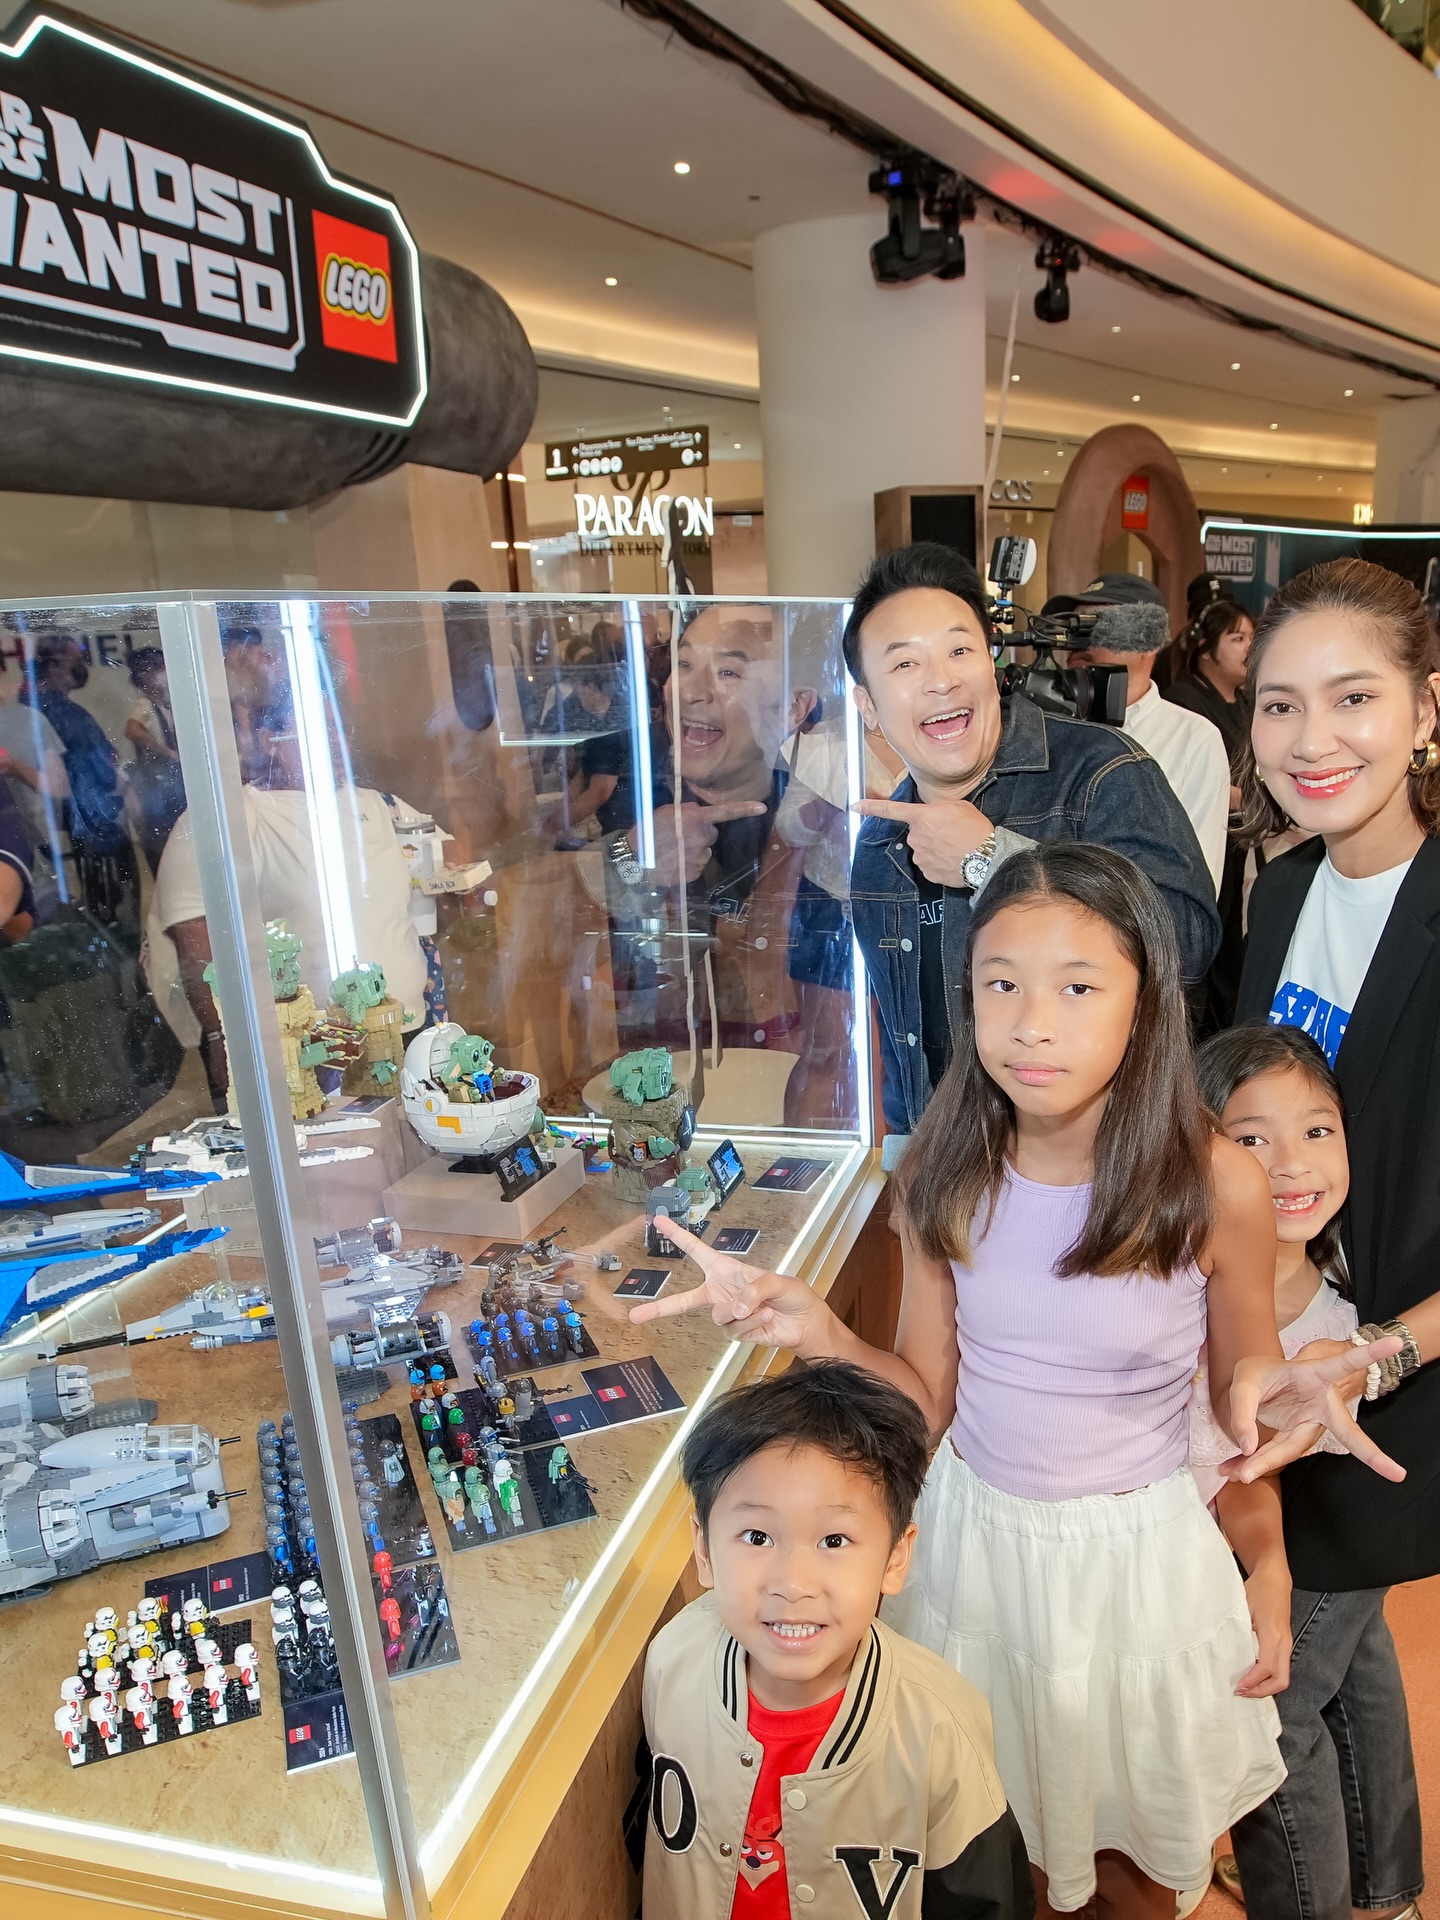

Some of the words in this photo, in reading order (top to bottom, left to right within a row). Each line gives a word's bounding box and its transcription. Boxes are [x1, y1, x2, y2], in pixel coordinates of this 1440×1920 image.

[41, 106, 281, 256] MOST
[324, 258, 389, 320] LEGO
[552, 448, 562, 467] 1
[991, 479, 1033, 503] COS
[1124, 490, 1148, 514] LEGO
[1221, 535, 1255, 553] MOST
[1206, 554, 1254, 573] WANTED
[832, 1844, 923, 1920] V
